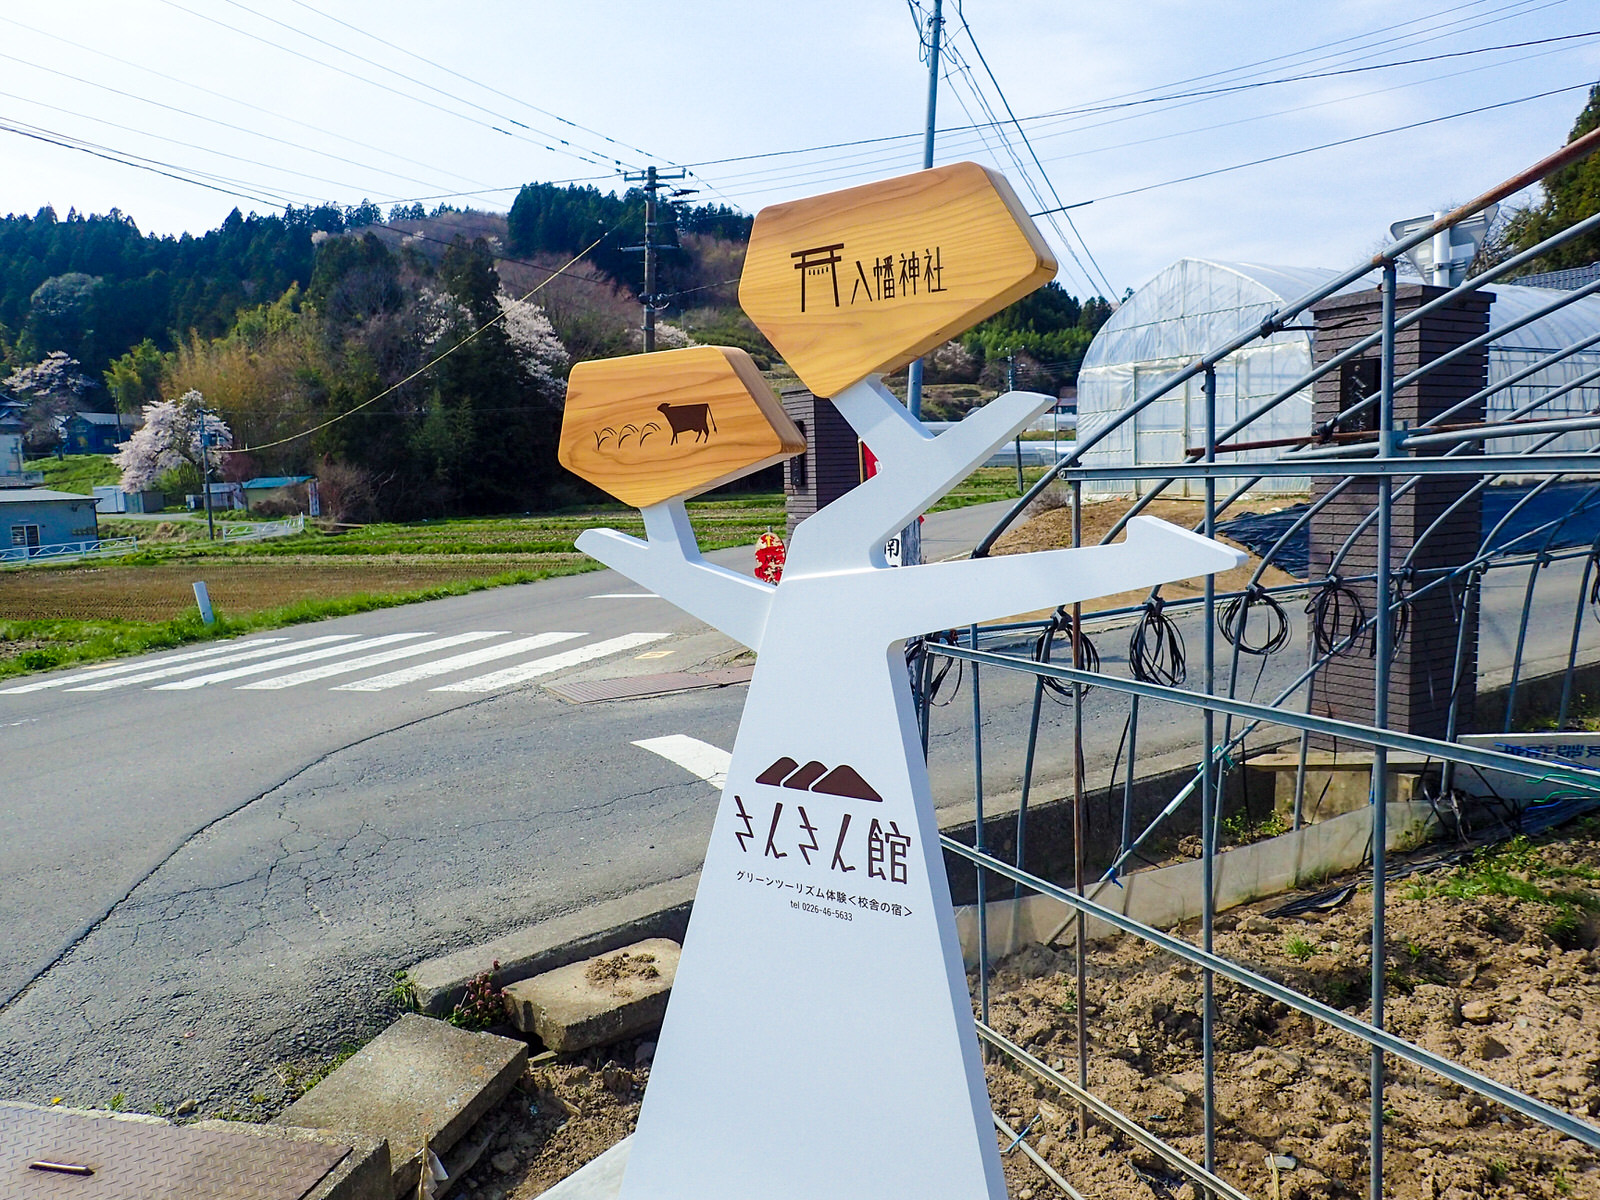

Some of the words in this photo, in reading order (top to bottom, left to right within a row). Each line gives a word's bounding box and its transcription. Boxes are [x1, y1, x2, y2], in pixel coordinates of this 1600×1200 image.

[850, 246, 948, 305] 八幡神社
[734, 795, 911, 885] さんさん館
[790, 899, 800, 910] tel
[802, 902, 852, 921] 0226-46-5633
